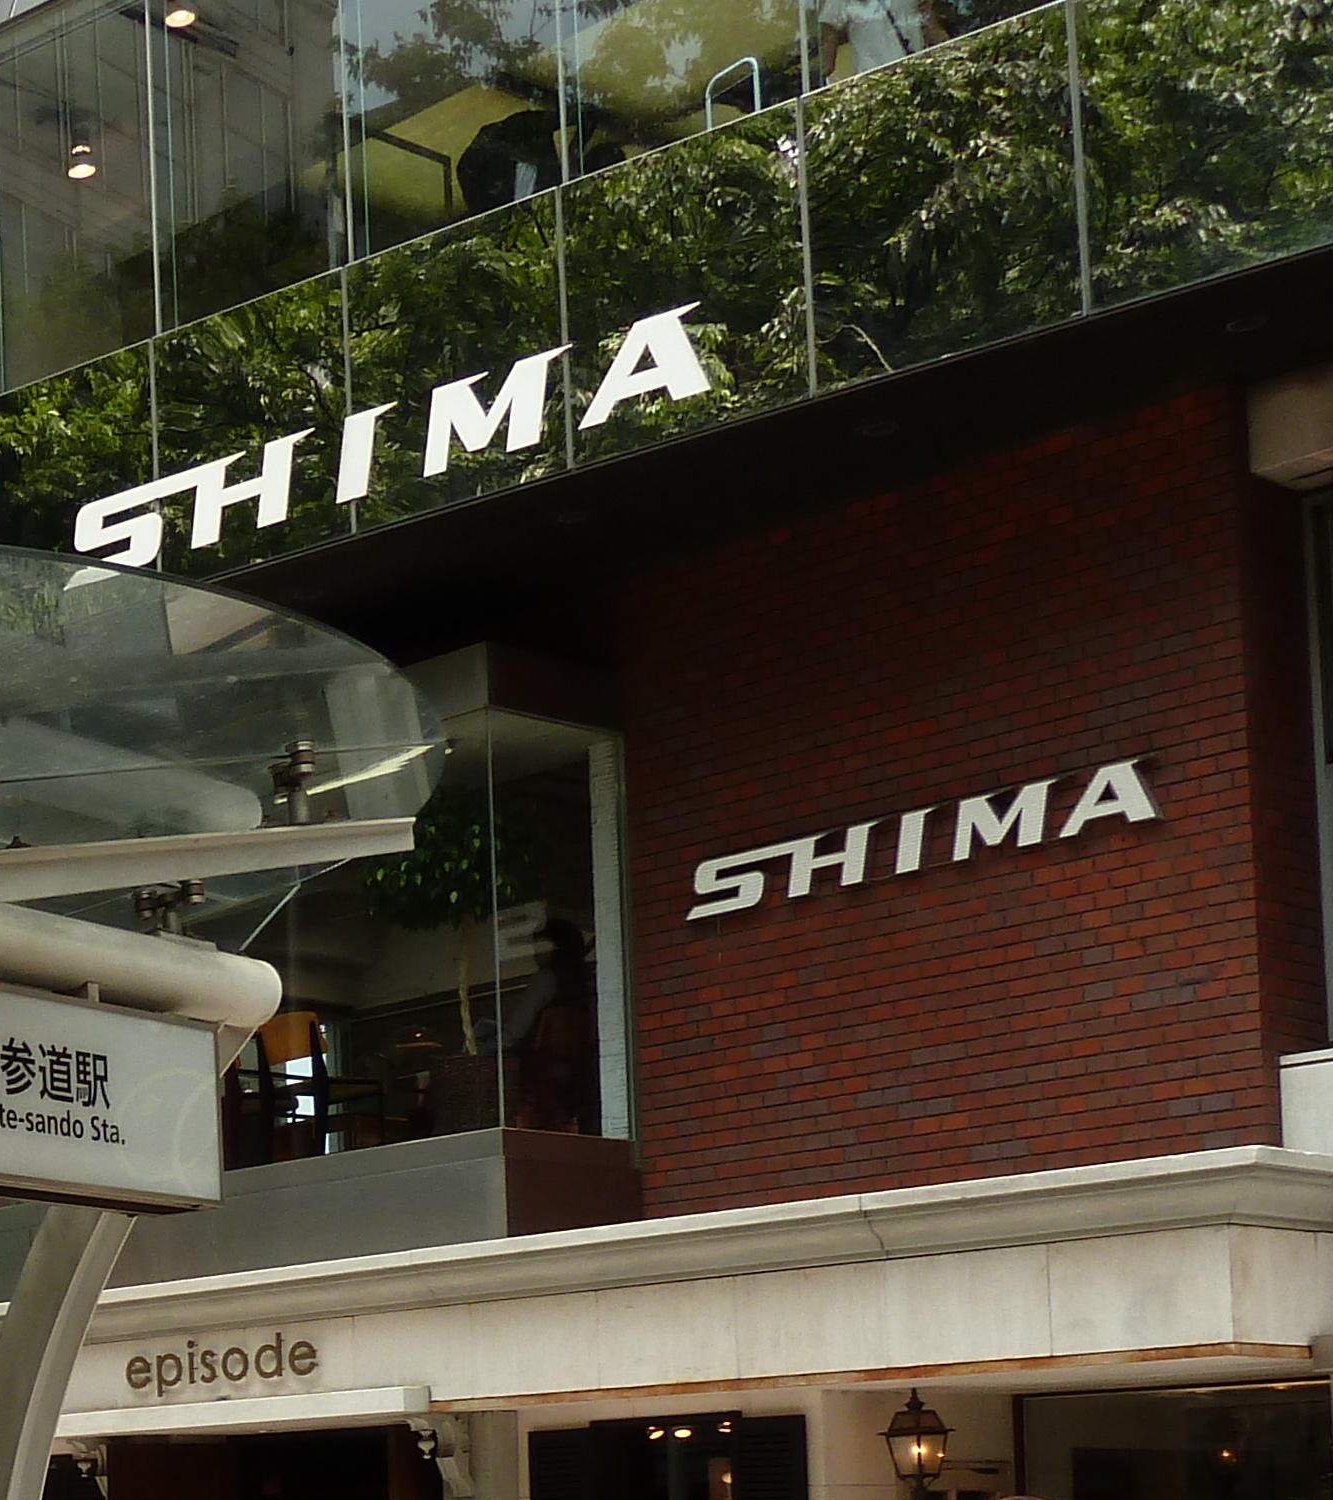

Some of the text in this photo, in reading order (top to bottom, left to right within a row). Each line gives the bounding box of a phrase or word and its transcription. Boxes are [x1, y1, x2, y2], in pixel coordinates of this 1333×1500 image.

[62, 300, 711, 591] SHIMA
[685, 757, 1161, 922] SHIMA
[90, 1118, 127, 1146] Sta.
[125, 1331, 319, 1398] episode
